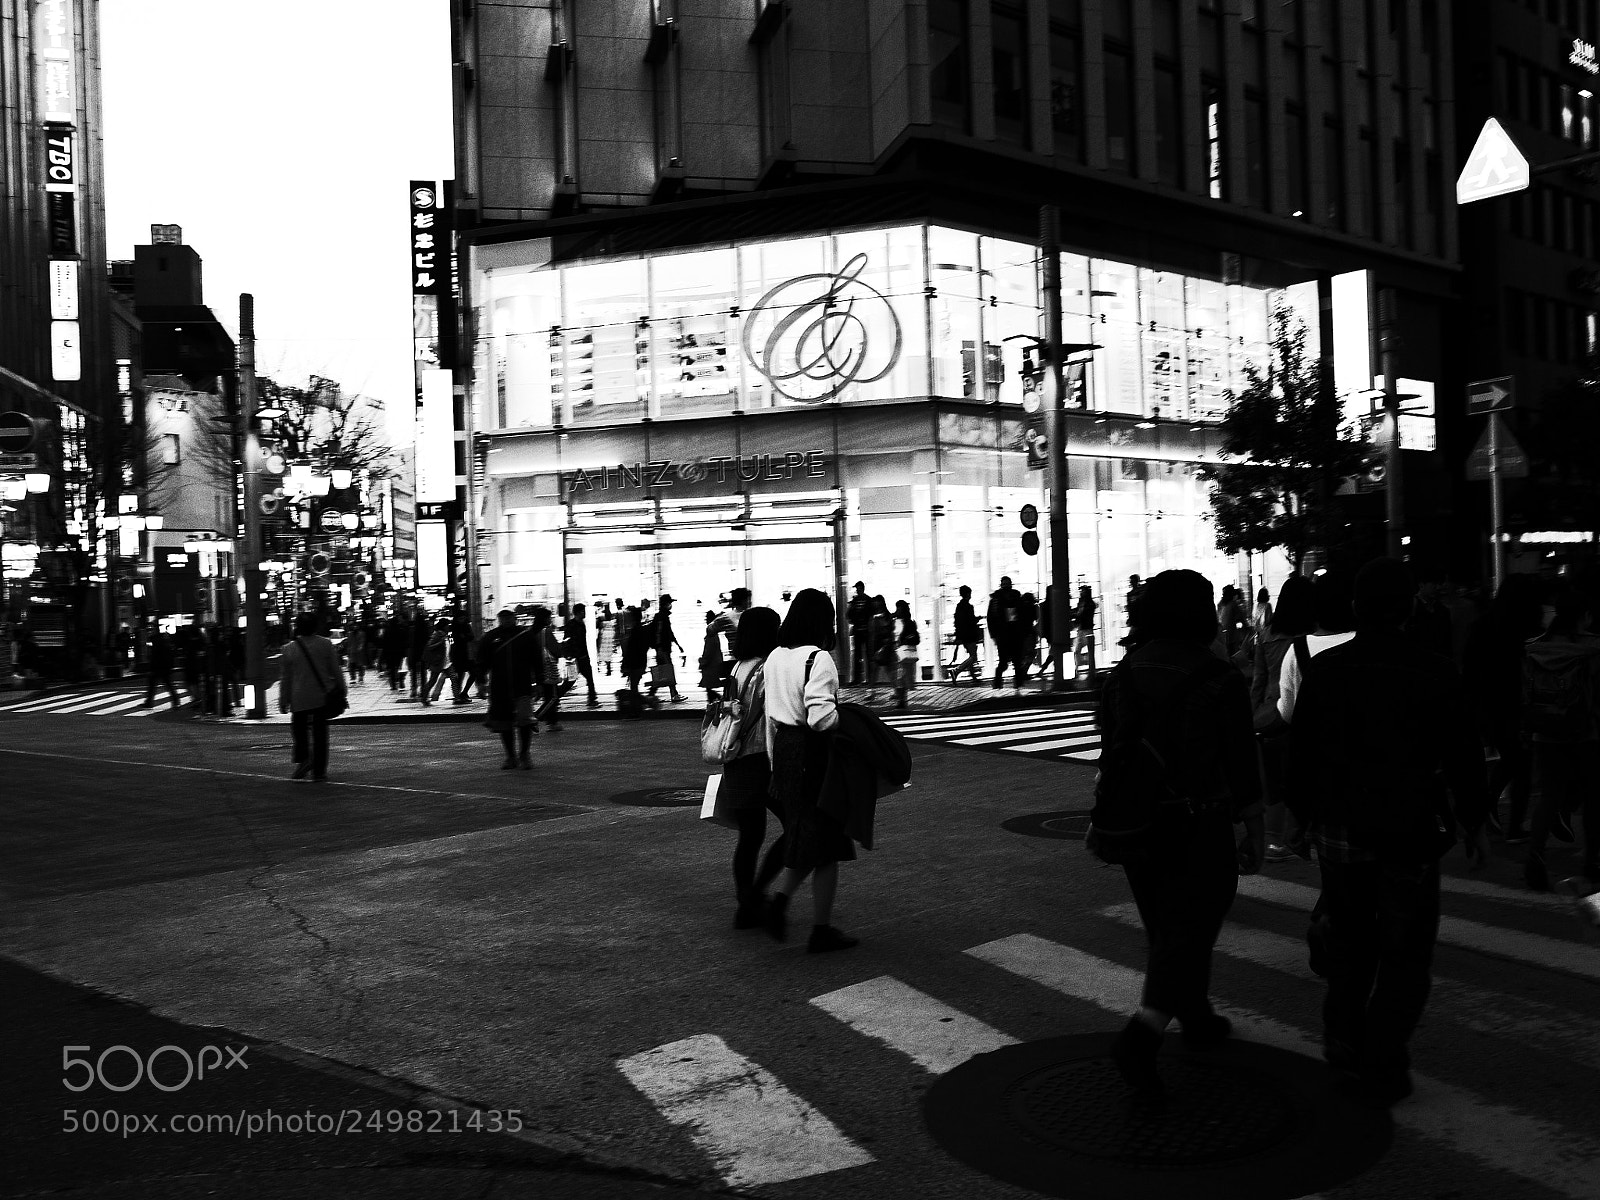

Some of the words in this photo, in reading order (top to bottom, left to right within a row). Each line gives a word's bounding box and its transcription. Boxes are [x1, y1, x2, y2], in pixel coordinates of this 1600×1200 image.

[569, 459, 673, 491] AINZ
[709, 449, 826, 483] TULPE
[420, 505, 442, 515] 1F
